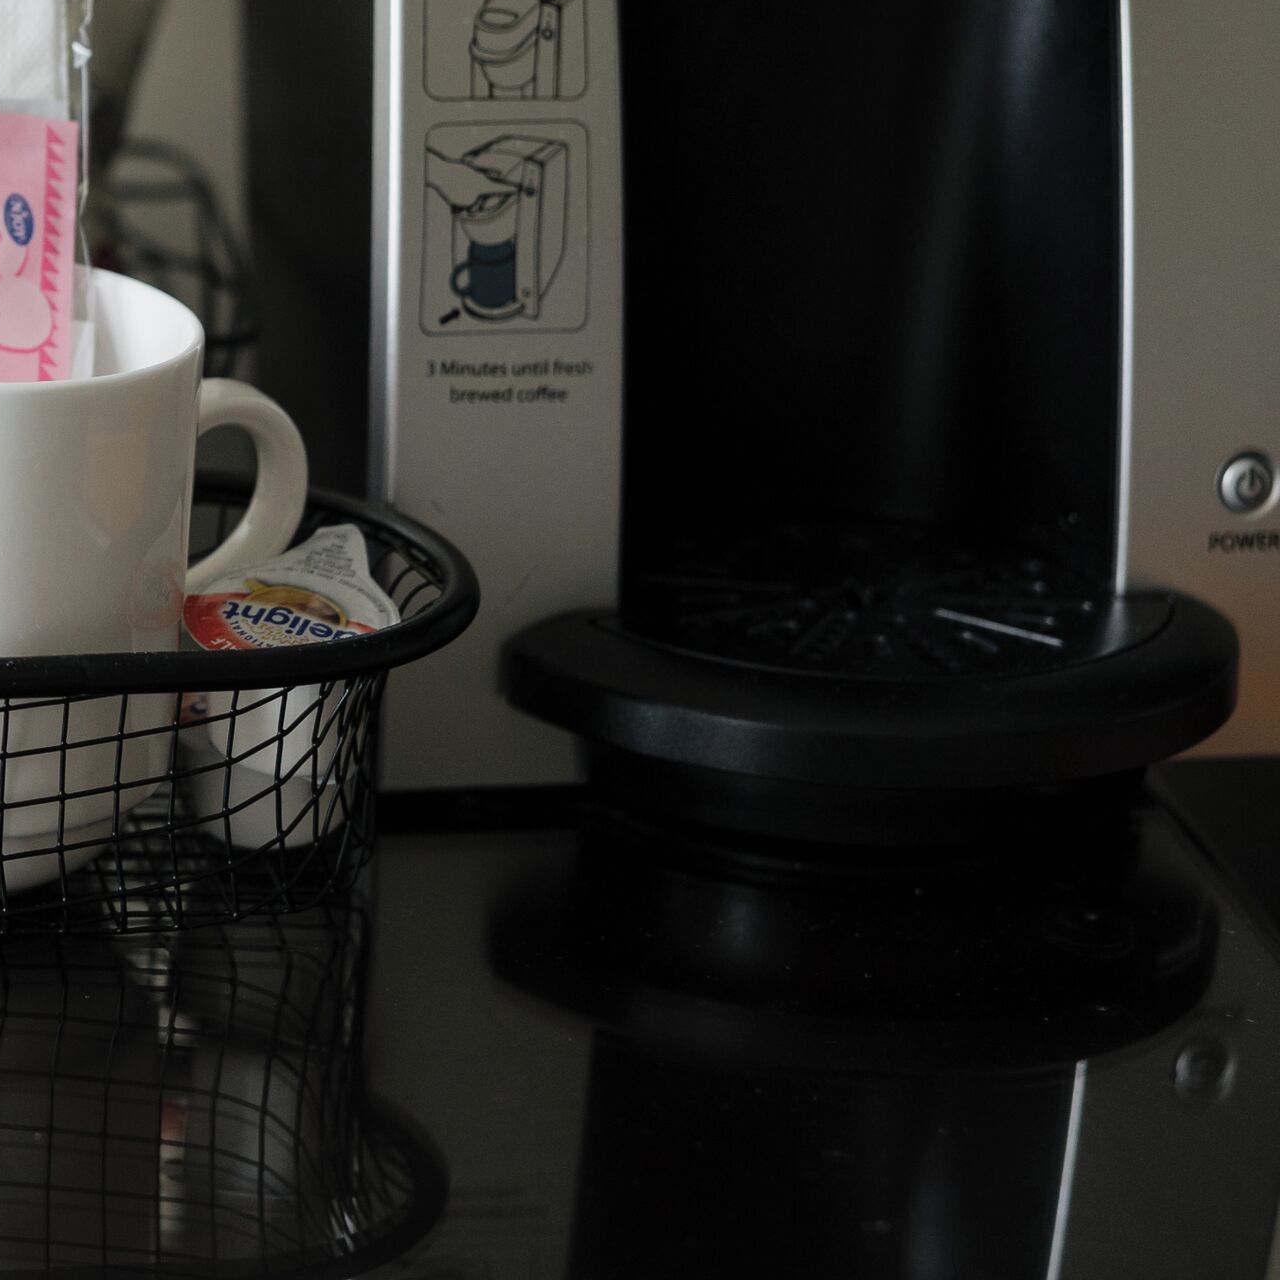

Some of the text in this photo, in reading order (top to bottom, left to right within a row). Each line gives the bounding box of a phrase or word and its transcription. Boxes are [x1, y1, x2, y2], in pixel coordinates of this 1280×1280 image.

[440, 359, 507, 377] Minutes
[511, 358, 548, 377] until
[552, 357, 592, 376] fresh
[449, 385, 569, 404] brewed coffee
